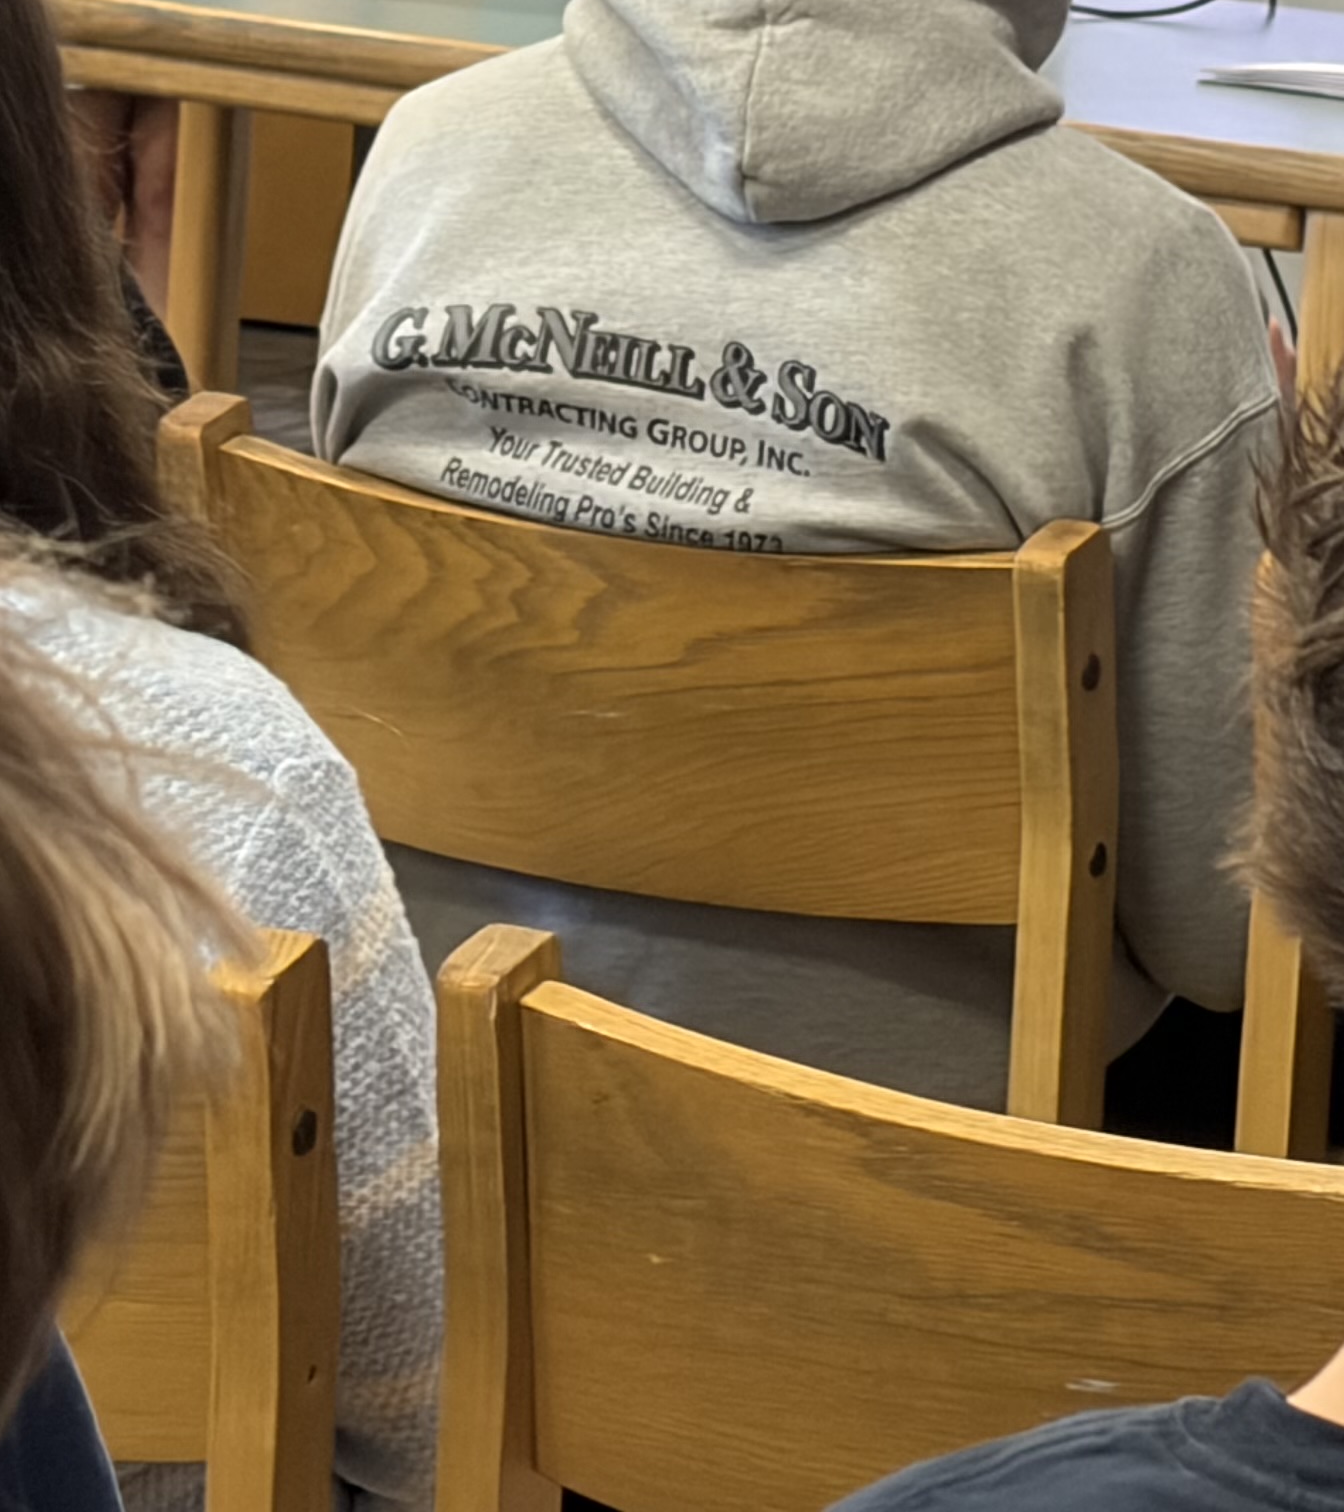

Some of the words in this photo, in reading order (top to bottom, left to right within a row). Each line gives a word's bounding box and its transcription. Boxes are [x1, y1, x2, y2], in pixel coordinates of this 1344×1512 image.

[709, 340, 766, 415] &
[440, 456, 570, 524] Remodeling
[573, 494, 638, 535] Pro's
[644, 511, 714, 548] Since
[488, 425, 540, 461] Your
[541, 439, 630, 487] Trusted
[627, 464, 727, 516] Building
[733, 487, 755, 514] &
